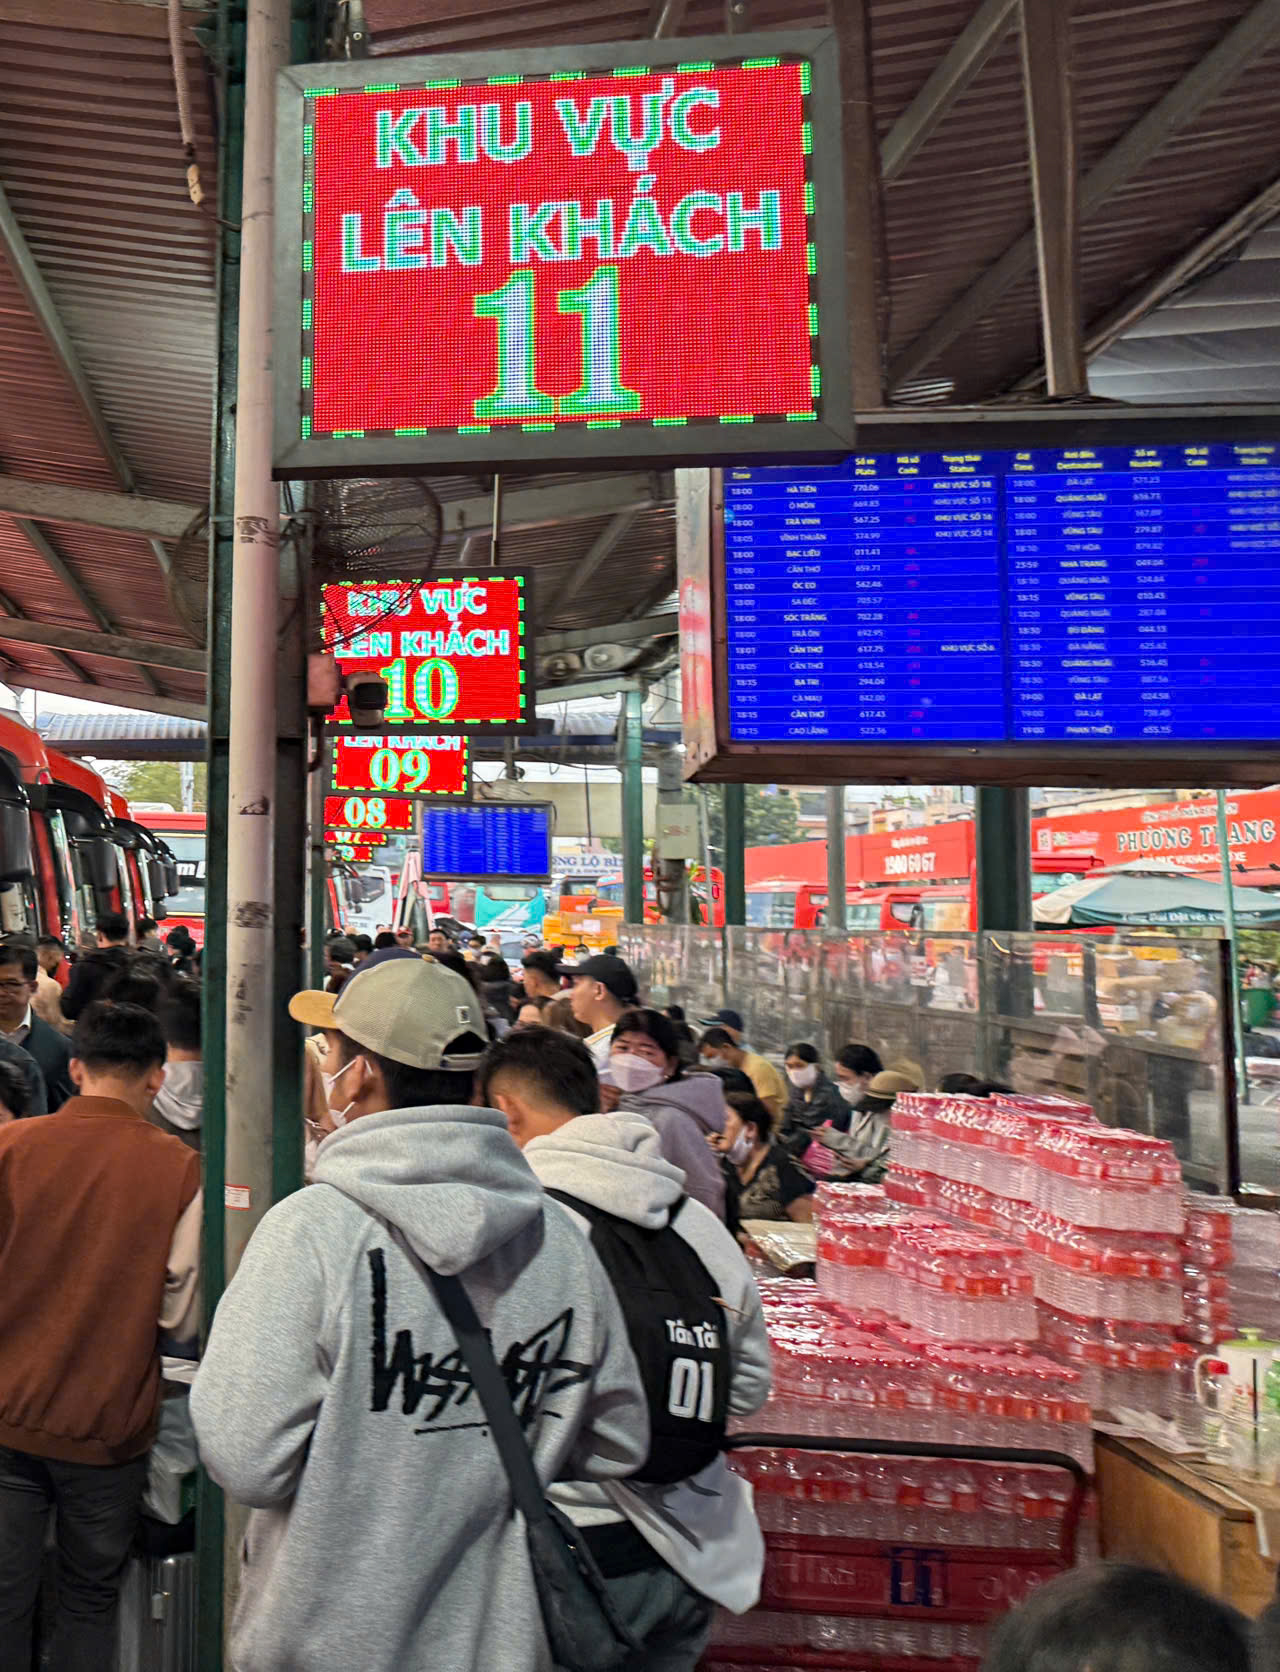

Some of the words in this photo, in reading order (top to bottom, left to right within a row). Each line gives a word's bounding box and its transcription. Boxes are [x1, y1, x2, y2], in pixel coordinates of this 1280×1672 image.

[375, 100, 532, 168] KHU
[555, 77, 721, 172] VỰC
[340, 187, 484, 274] LÊN
[508, 174, 783, 263] KHÁCH
[473, 264, 643, 419] 11
[419, 582, 488, 622] VỰC
[400, 621, 510, 657] KHÁCH
[380, 657, 459, 719] 10
[369, 748, 431, 790] 09
[344, 796, 387, 828] 08
[669, 1357, 713, 1423] 01
